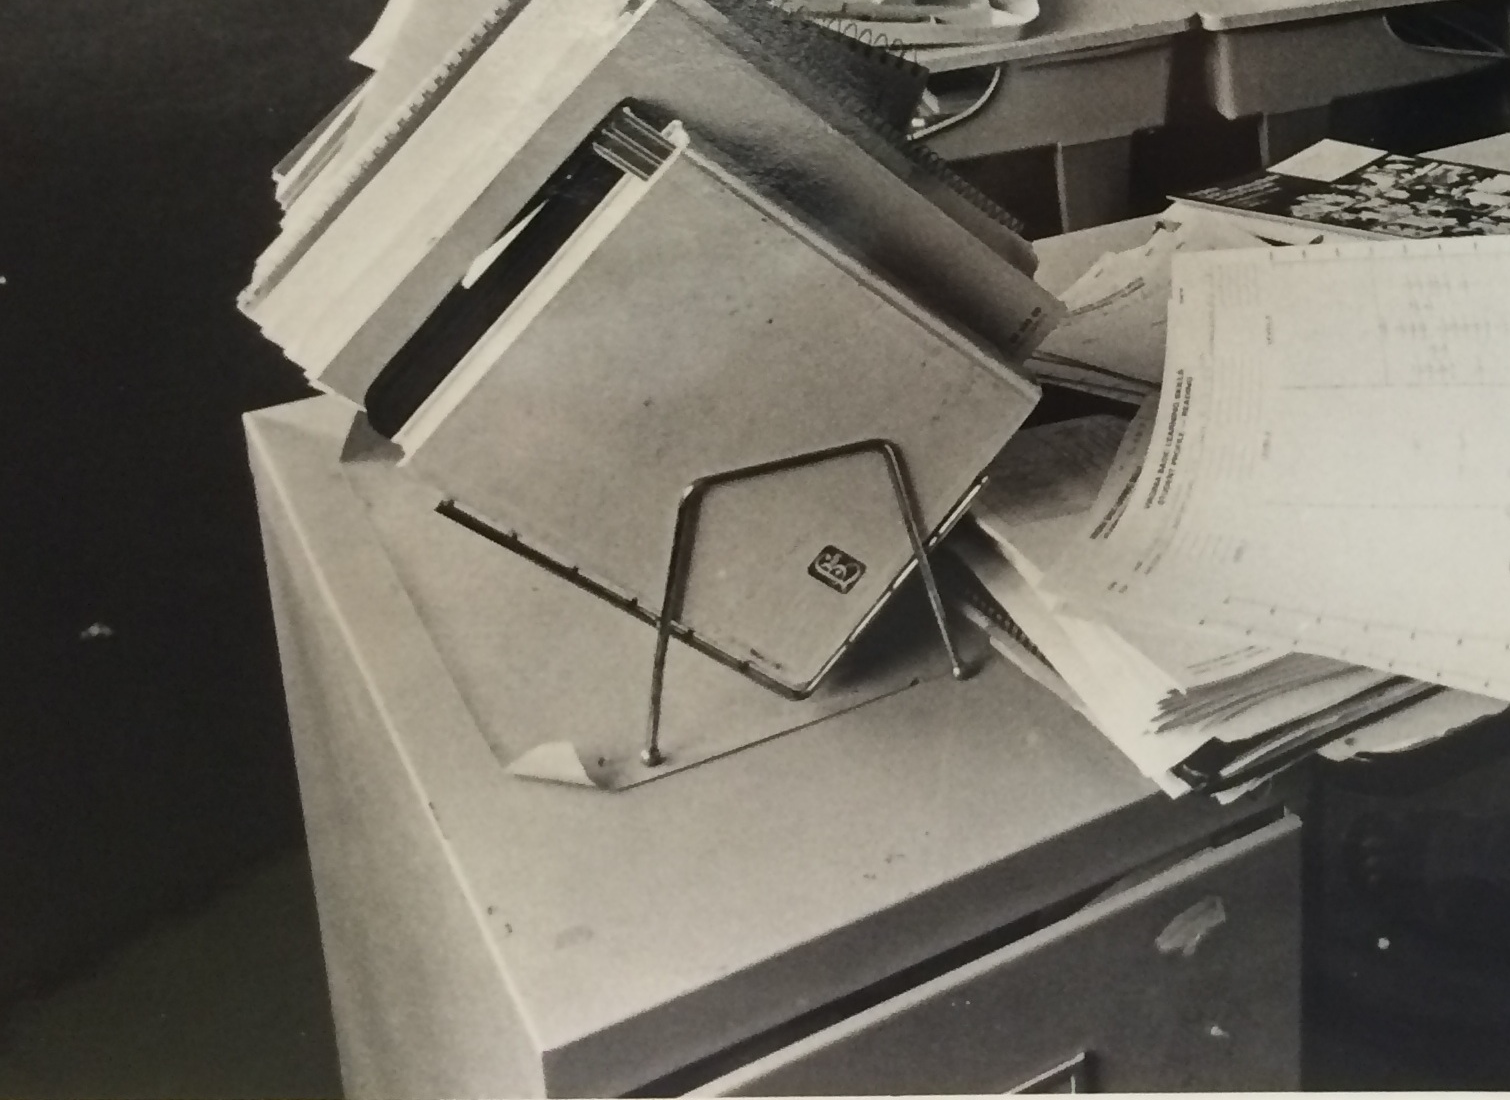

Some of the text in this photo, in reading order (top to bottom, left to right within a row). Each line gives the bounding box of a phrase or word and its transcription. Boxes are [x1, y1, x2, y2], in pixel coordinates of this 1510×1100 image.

[1165, 402, 1180, 446] LEARNING
[1174, 369, 1184, 399] SKILLS
[1181, 376, 1193, 417] READING
